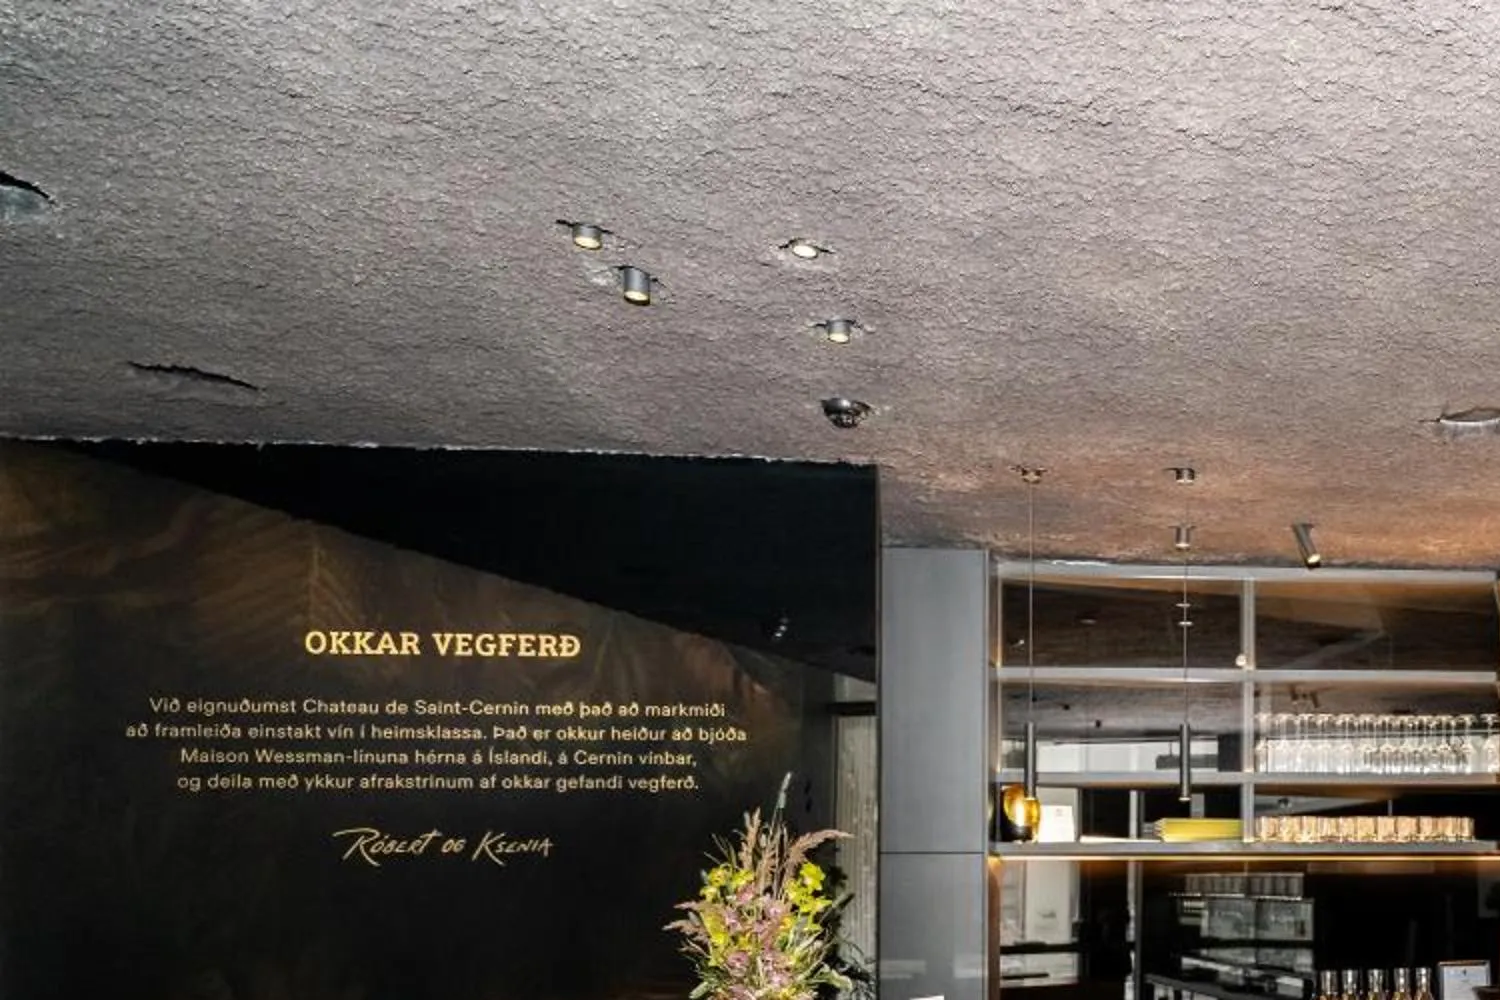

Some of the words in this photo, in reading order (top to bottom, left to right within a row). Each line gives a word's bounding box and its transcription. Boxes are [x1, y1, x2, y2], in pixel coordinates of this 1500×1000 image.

[304, 630, 421, 656] OKKAR
[431, 632, 582, 658] VEGFERÐ
[150, 698, 180, 713] Við
[186, 698, 296, 717] eignuðumst
[303, 699, 379, 714] Chateau
[385, 699, 409, 714] de
[414, 699, 529, 716] Saint-Cernin
[535, 701, 573, 716] með
[579, 701, 613, 719] það
[618, 701, 639, 717] að
[644, 702, 725, 718] markmiði
[126, 722, 149, 738] að
[154, 723, 241, 738] framleiða
[247, 724, 321, 739] einstakt
[371, 724, 487, 740] heimsklassa.
[493, 726, 527, 740] Það
[533, 730, 550, 741] er
[556, 726, 604, 741] okkur
[610, 726, 665, 742] heiður
[671, 726, 693, 742] að
[698, 725, 747, 745] bjóða
[180, 748, 249, 764] Maison
[254, 748, 408, 765] Wessman-línuna
[414, 748, 466, 765] hérna
[573, 750, 632, 766] Cernin
[177, 777, 200, 791] og
[207, 774, 252, 789] deila
[258, 774, 299, 789] með
[304, 774, 354, 793] ykkur
[359, 773, 474, 789] afrakstrinum
[479, 774, 496, 789] af
[501, 775, 550, 790] okkar
[556, 774, 623, 793] gefandi
[628, 775, 699, 793] vegferð.
